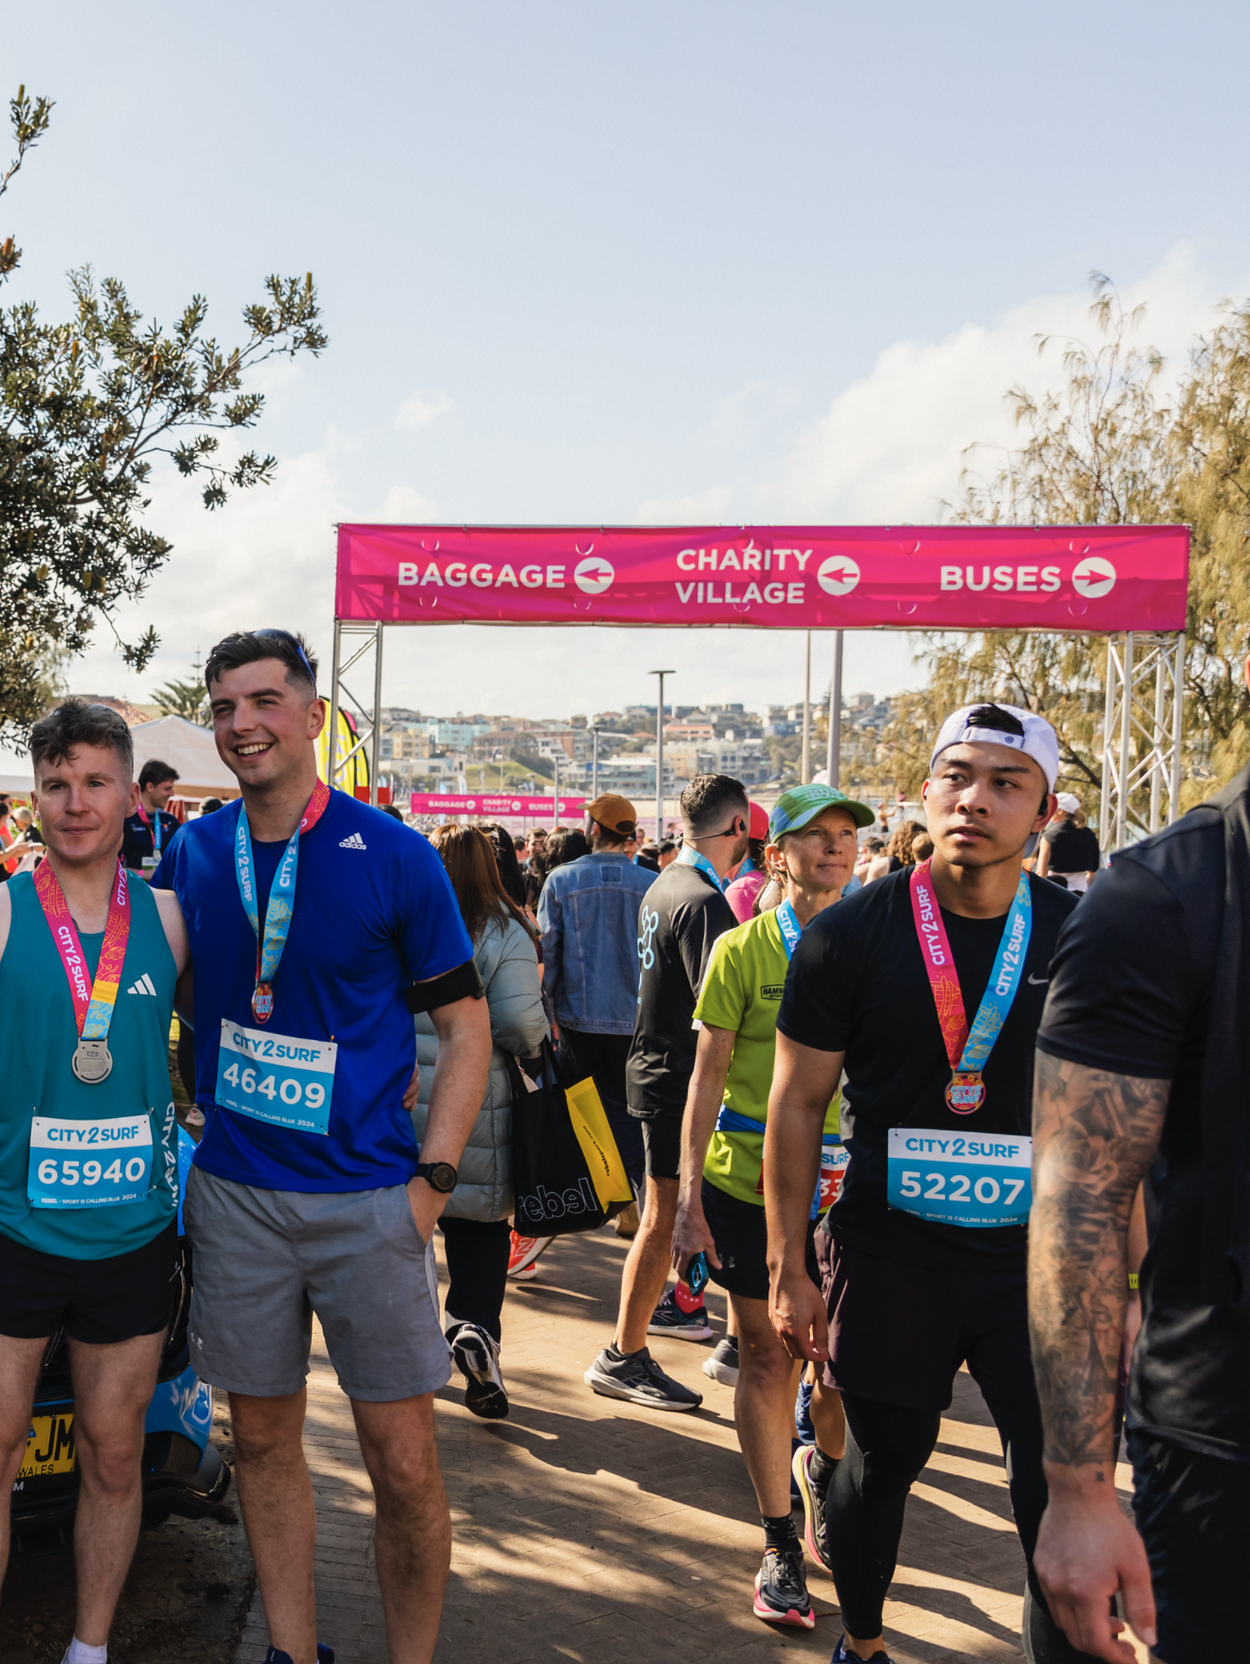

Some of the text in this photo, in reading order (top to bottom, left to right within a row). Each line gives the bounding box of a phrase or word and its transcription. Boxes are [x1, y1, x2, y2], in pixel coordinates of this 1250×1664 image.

[675, 548, 813, 571] CHARITY
[398, 562, 566, 588] BAGGAGE
[939, 565, 1062, 592] BUSES
[675, 582, 805, 604] VILLAGE
[428, 800, 465, 809] BAGGAGE
[528, 803, 554, 811] BUSES
[338, 841, 367, 850] adidas
[223, 1063, 326, 1109] 46409
[241, 1104, 255, 1114] SPORT
[260, 1110, 281, 1121] CALLING
[297, 1119, 315, 1128] 2024
[583, 1124, 611, 1177] rebelsport.com
[38, 1157, 146, 1186] 65940
[122, 1193, 137, 1201] 2024
[518, 1177, 598, 1222] rebel
[899, 1170, 1025, 1205] 52207
[926, 1212, 946, 1220] SPORT
